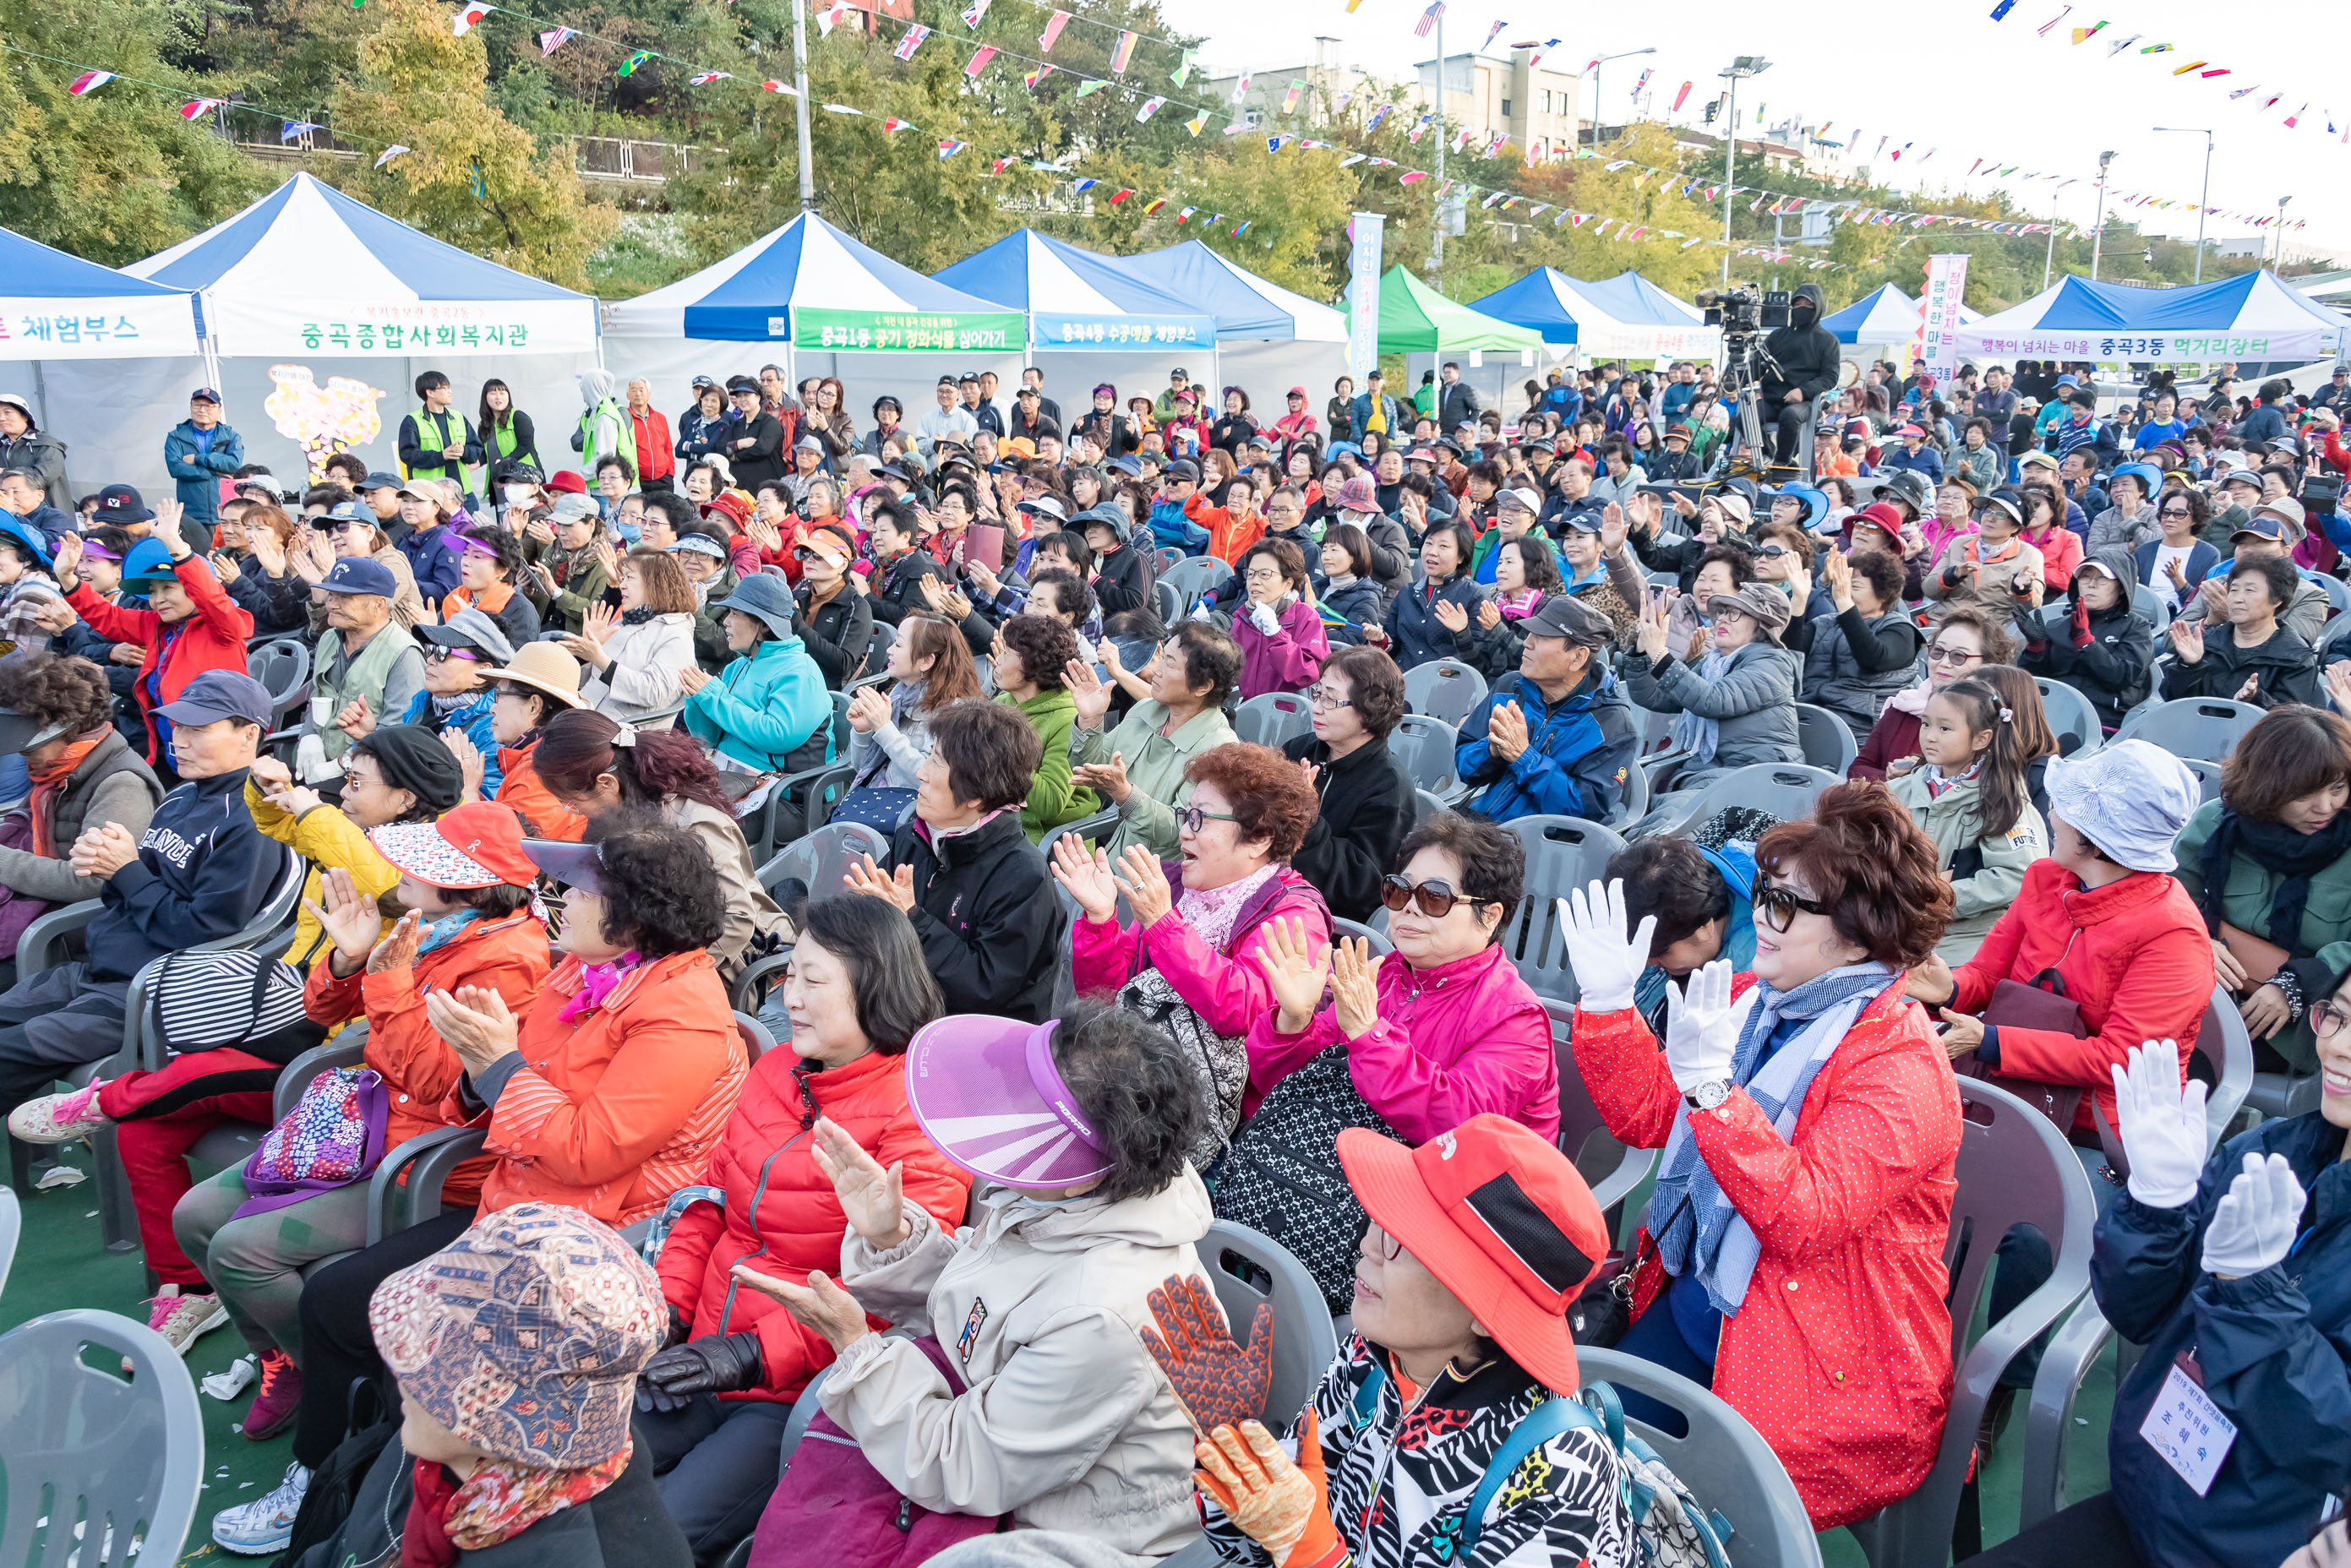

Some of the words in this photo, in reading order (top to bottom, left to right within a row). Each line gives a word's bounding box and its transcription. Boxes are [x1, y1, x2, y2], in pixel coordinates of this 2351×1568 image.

[1930, 280, 1945, 324] 행복한
[21, 315, 139, 343] 체험부스
[301, 323, 529, 349] 중곡종합사회복지관
[820, 325, 871, 347] 중곡1동
[875, 327, 901, 347] 공기
[905, 329, 956, 349] 정화식물
[958, 329, 1006, 349] 심어가기
[1062, 323, 1105, 343] 중곡4동
[1155, 324, 1197, 343] 체험부스
[1926, 330, 1939, 359] 마을
[1982, 339, 2017, 353] 행복이
[2022, 339, 2060, 354] 넘치는
[2064, 339, 2090, 355] 마을
[2099, 338, 2166, 357] 중곡3동
[2174, 337, 2269, 356] 먹거리장터
[2173, 1371, 2187, 1388] 2019
[2187, 1386, 2203, 1405] 제7회
[2178, 1400, 2210, 1437] 추진위원
